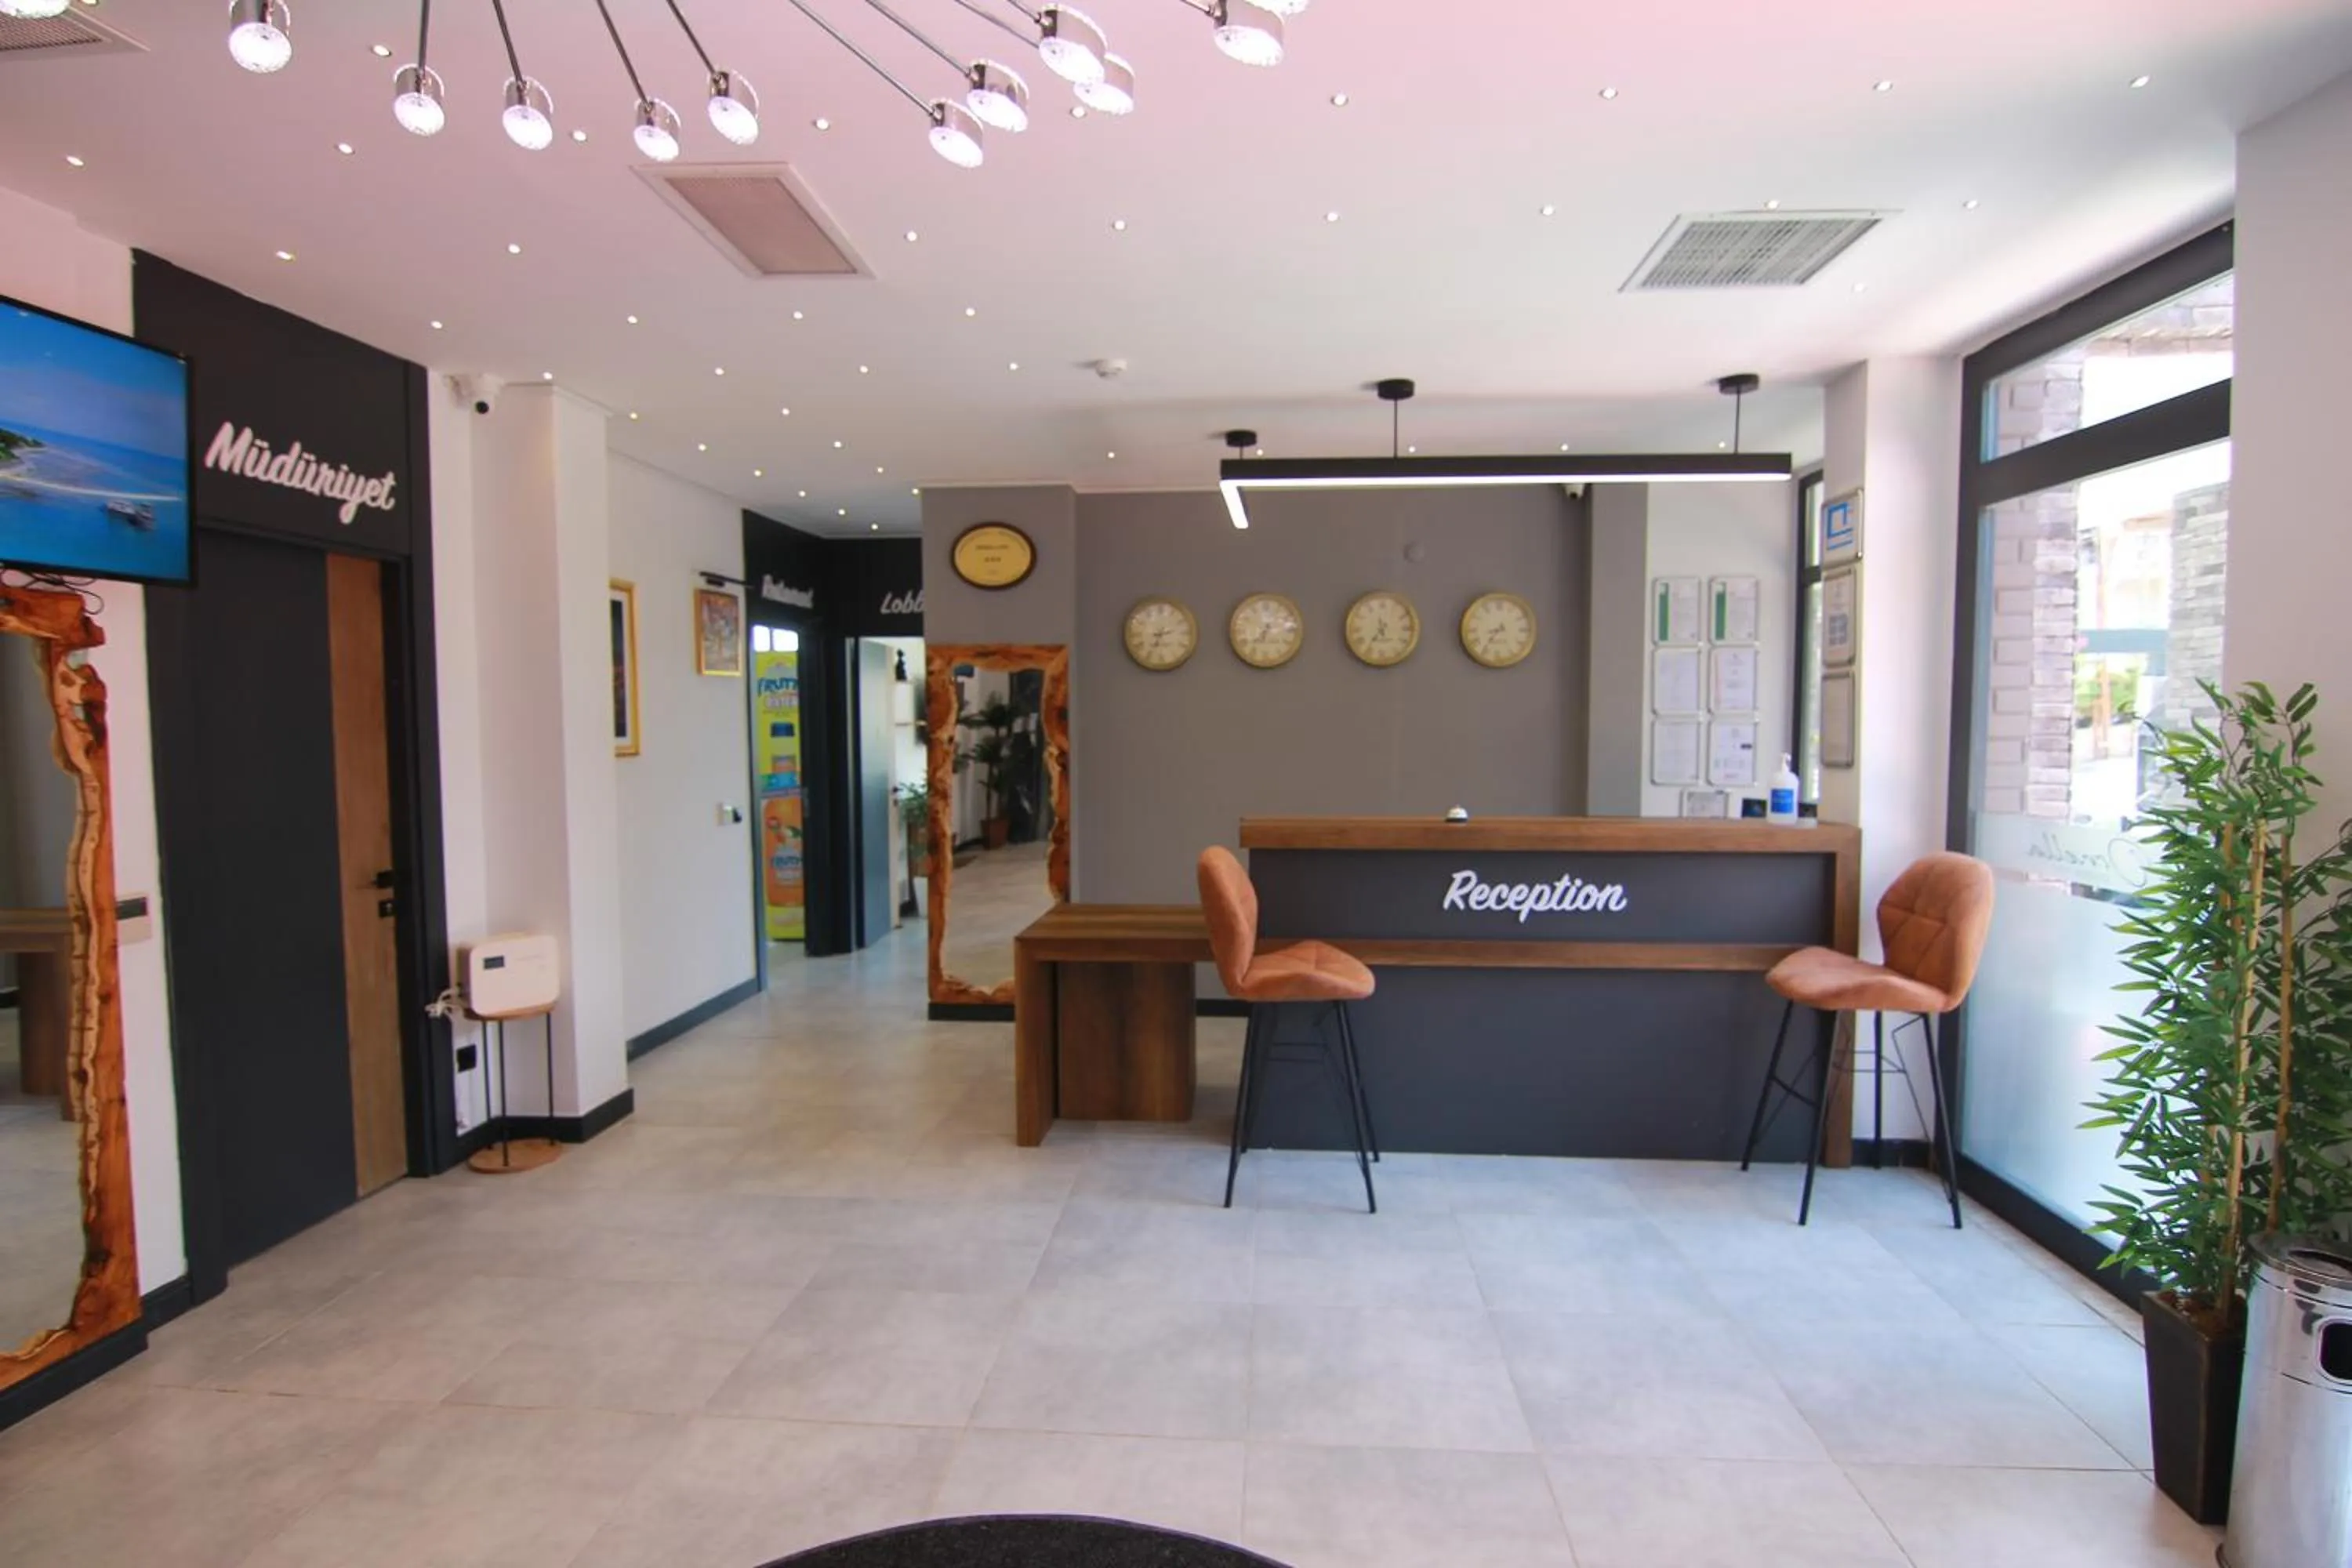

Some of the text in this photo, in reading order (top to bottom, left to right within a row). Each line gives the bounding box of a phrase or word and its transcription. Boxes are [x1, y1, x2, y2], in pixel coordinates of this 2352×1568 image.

[204, 420, 396, 524] Müdüriyet
[880, 590, 925, 615] Lobb
[757, 677, 799, 697] FRUTT
[1443, 869, 1628, 924] Reception
